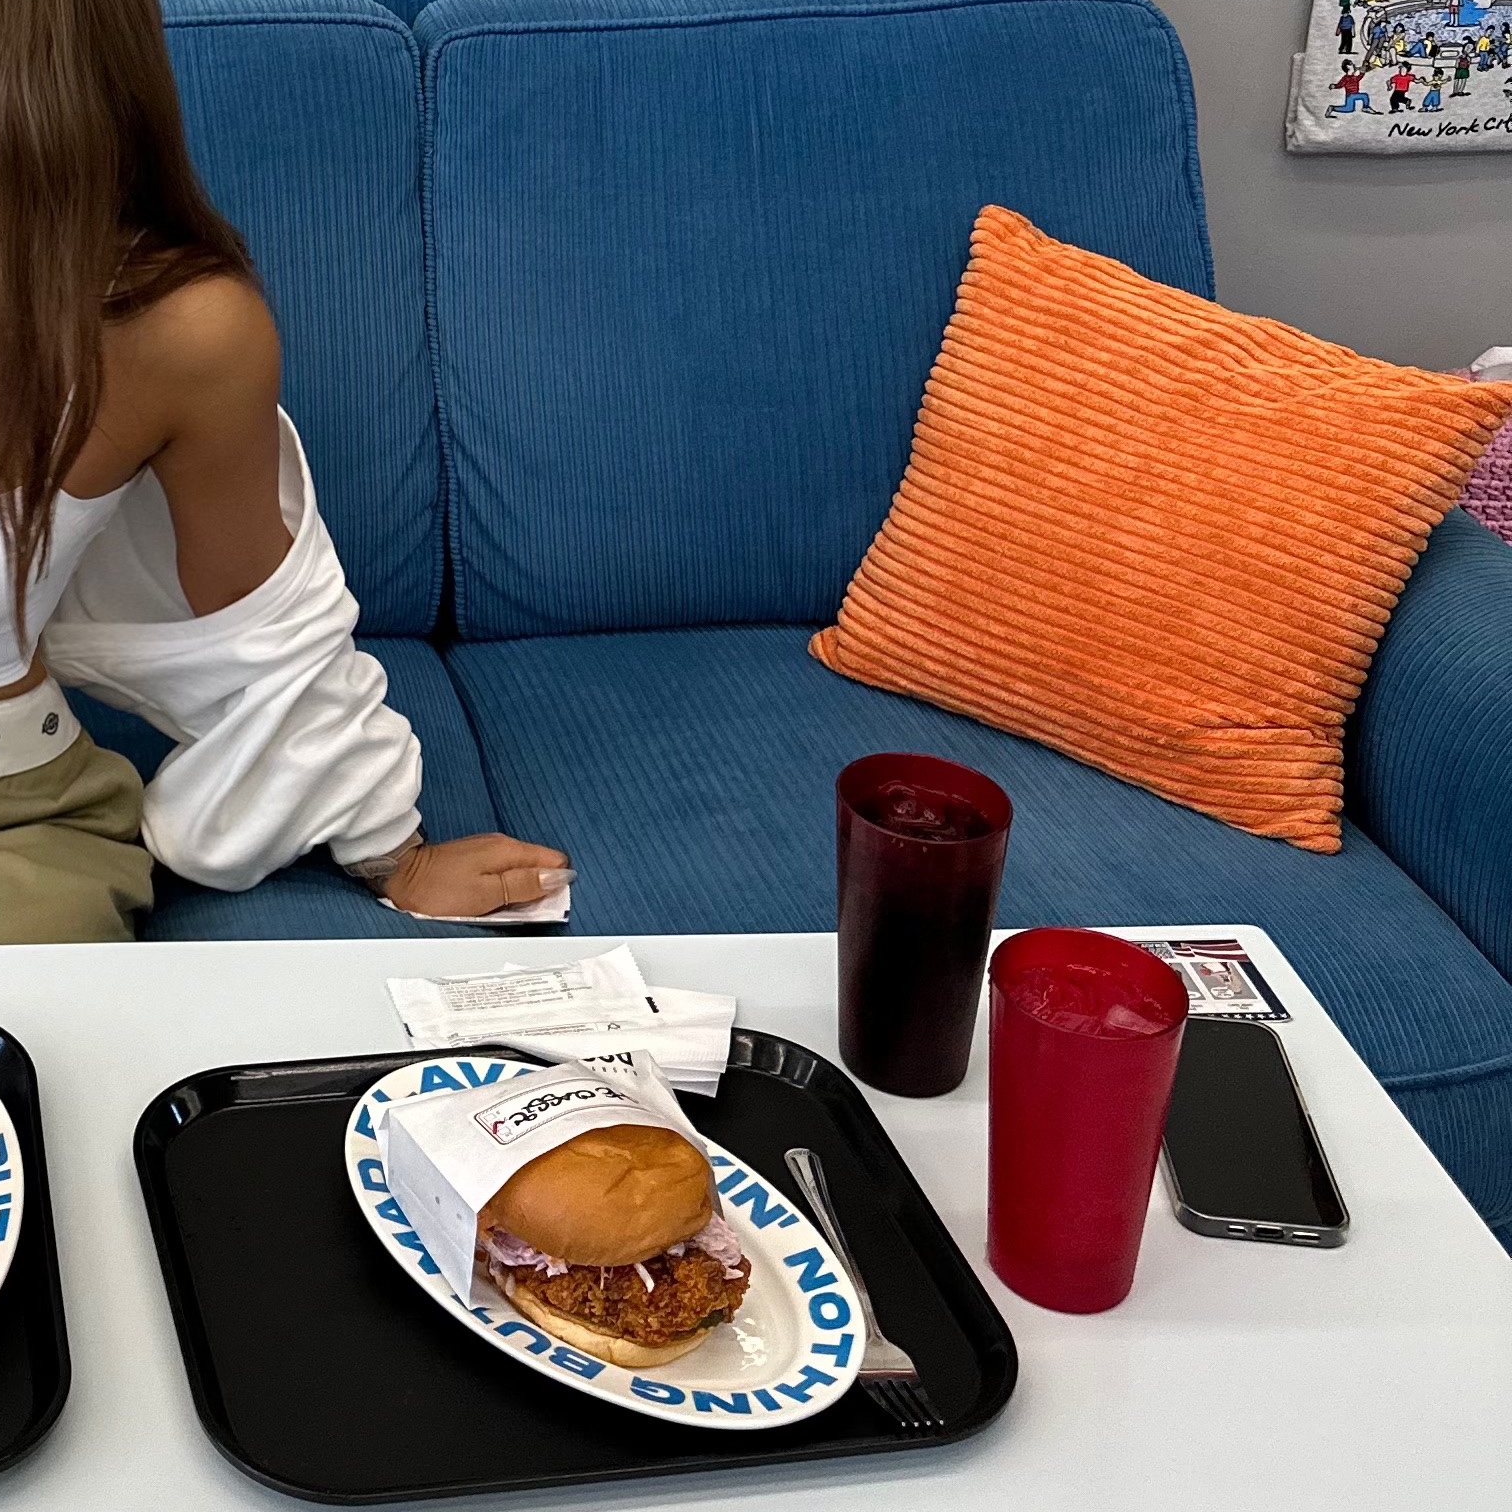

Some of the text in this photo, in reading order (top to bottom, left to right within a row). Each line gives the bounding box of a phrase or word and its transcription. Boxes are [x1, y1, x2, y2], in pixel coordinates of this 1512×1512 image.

[1388, 122, 1432, 137] New
[1436, 118, 1479, 137] York
[630, 1247, 855, 1414] NOTHING
